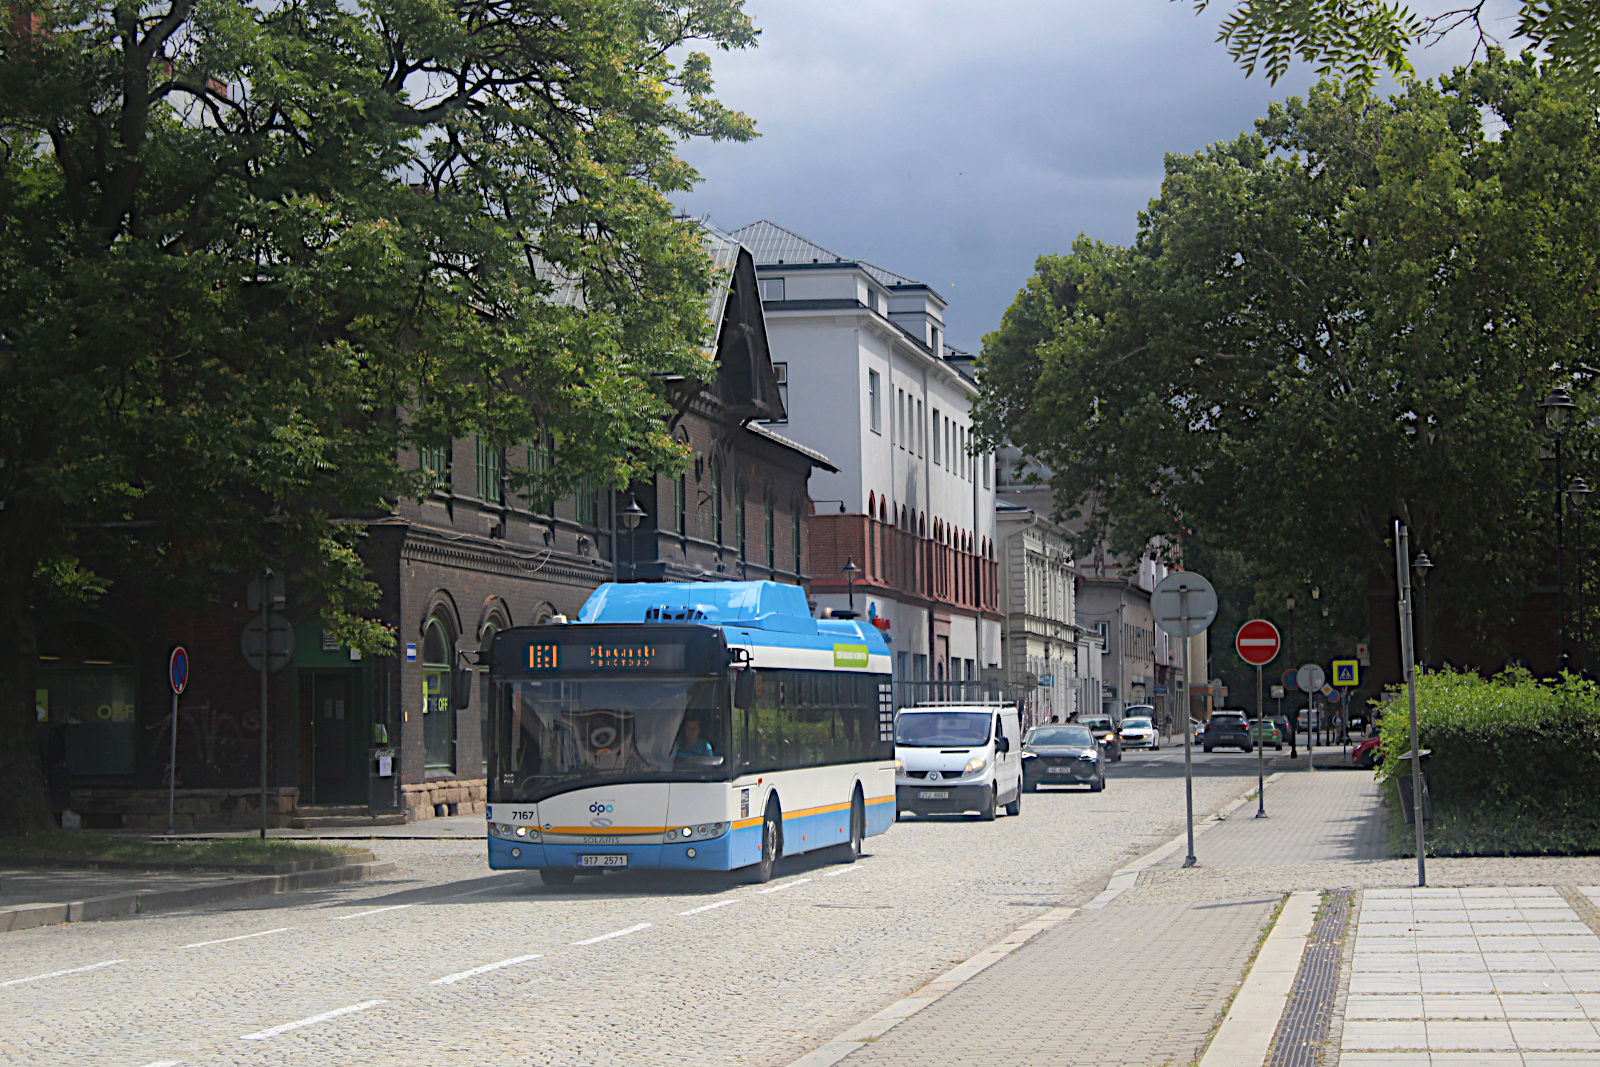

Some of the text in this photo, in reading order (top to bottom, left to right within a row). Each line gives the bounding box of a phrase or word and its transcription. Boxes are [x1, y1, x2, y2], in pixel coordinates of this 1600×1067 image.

[438, 697, 448, 711] OFF
[97, 704, 135, 719] OFF
[512, 811, 534, 820] 7167
[589, 801, 614, 816] dpo
[583, 856, 624, 865] 9T7 2571
